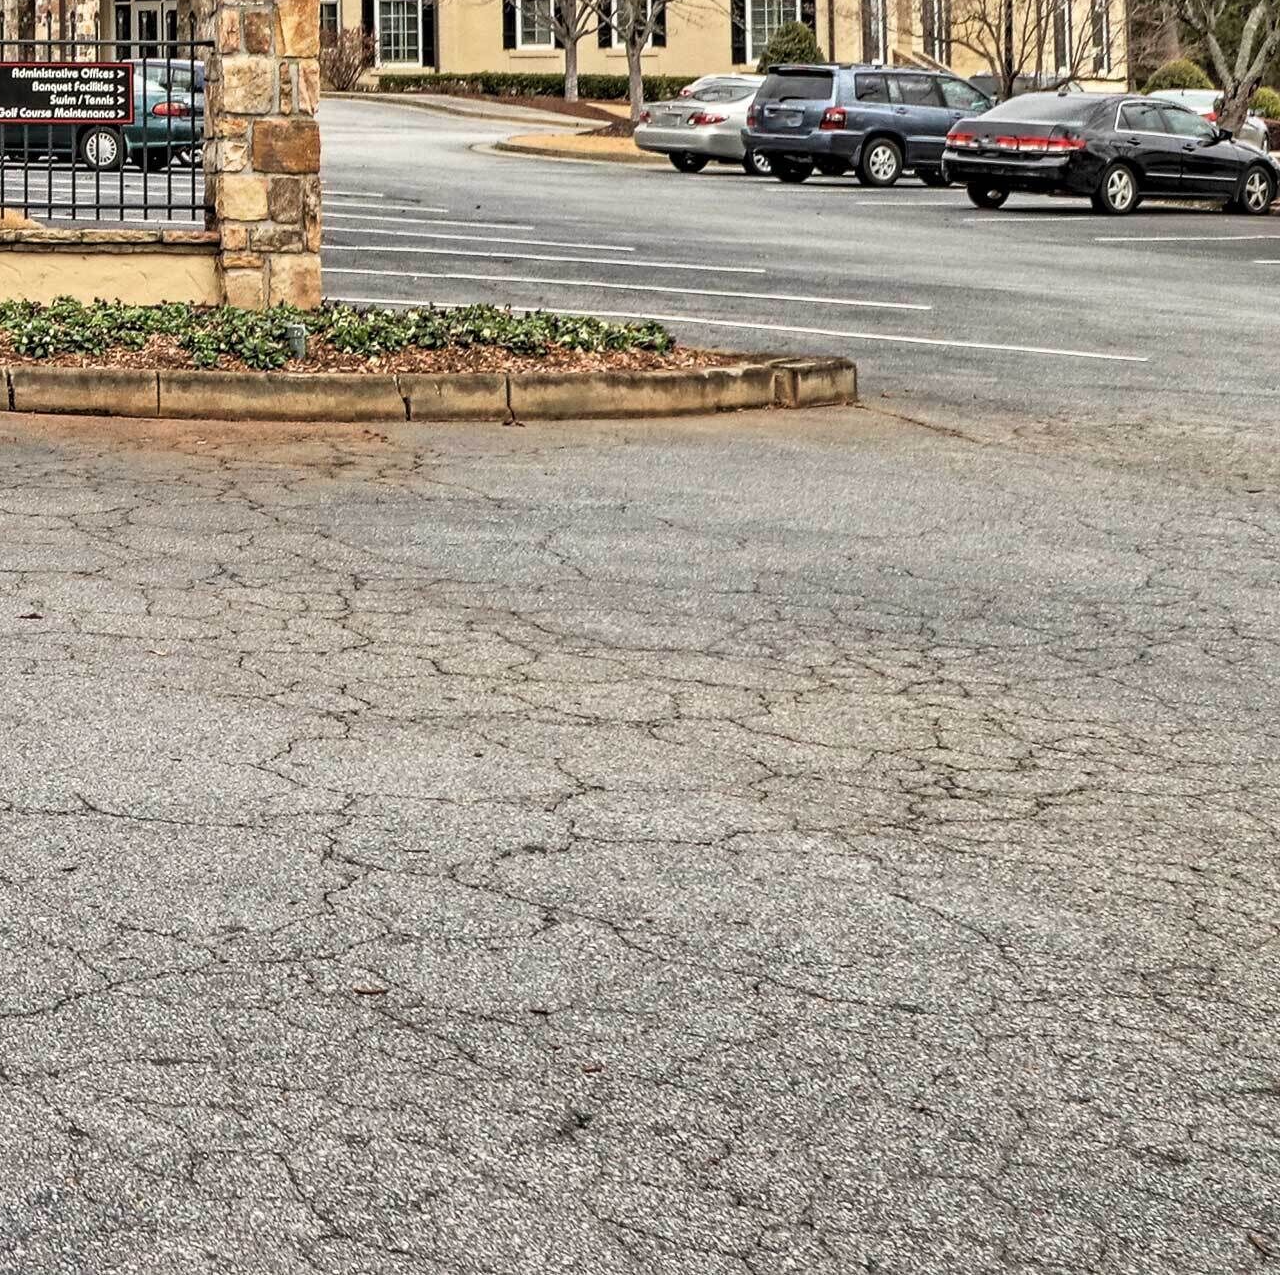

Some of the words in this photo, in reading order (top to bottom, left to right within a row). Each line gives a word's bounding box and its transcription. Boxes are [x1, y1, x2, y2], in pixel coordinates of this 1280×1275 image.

[11, 68, 79, 79] Administrative
[80, 68, 114, 79] Offices
[32, 81, 73, 94] Banquet
[74, 81, 114, 92] Facilities
[49, 94, 76, 105] Swim
[84, 94, 114, 105] Tennis
[20, 107, 52, 118] Course
[54, 107, 116, 119] Maintenance
